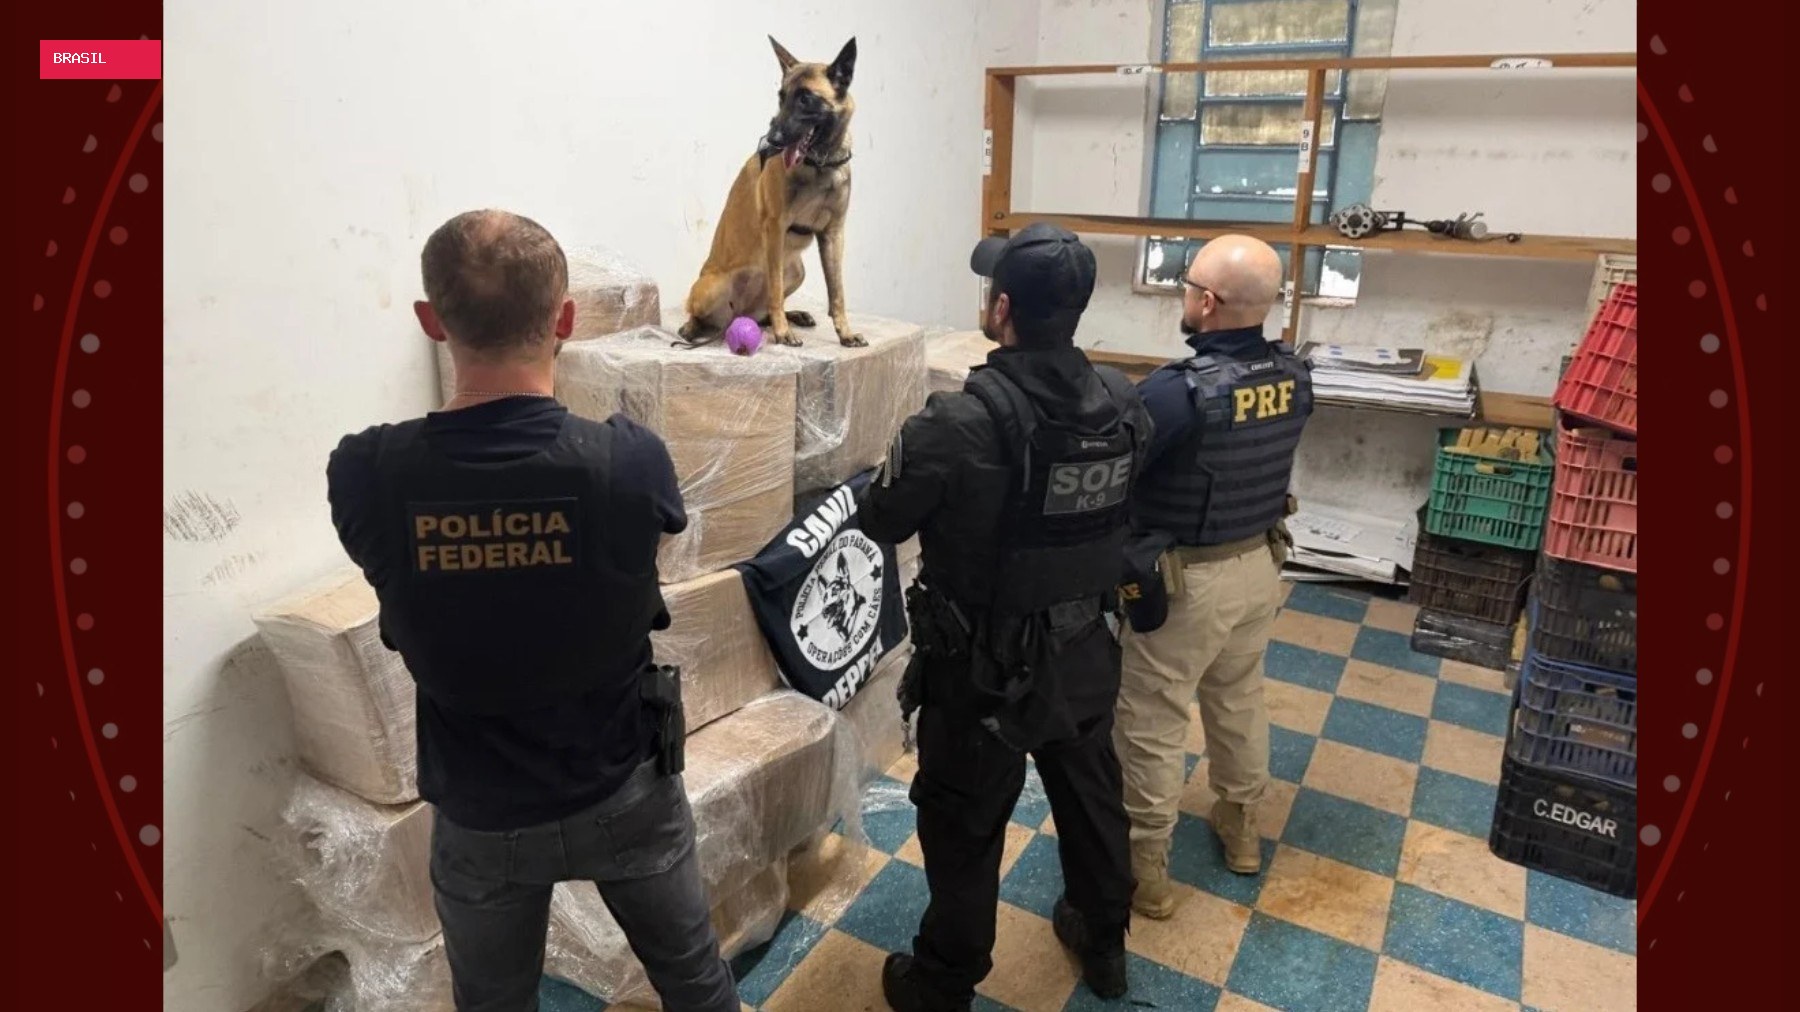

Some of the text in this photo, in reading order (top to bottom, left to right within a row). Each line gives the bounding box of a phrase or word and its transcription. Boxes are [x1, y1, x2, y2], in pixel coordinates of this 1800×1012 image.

[1234, 379, 1296, 423] PRF
[1052, 457, 1131, 495] SOE
[1076, 492, 1106, 509] K-9
[415, 508, 570, 539] POLÍCIA
[786, 484, 859, 558] CANIL
[418, 540, 573, 571] FEDERAL
[853, 621, 871, 645] COM
[1533, 798, 1618, 838] C.EDGAR
